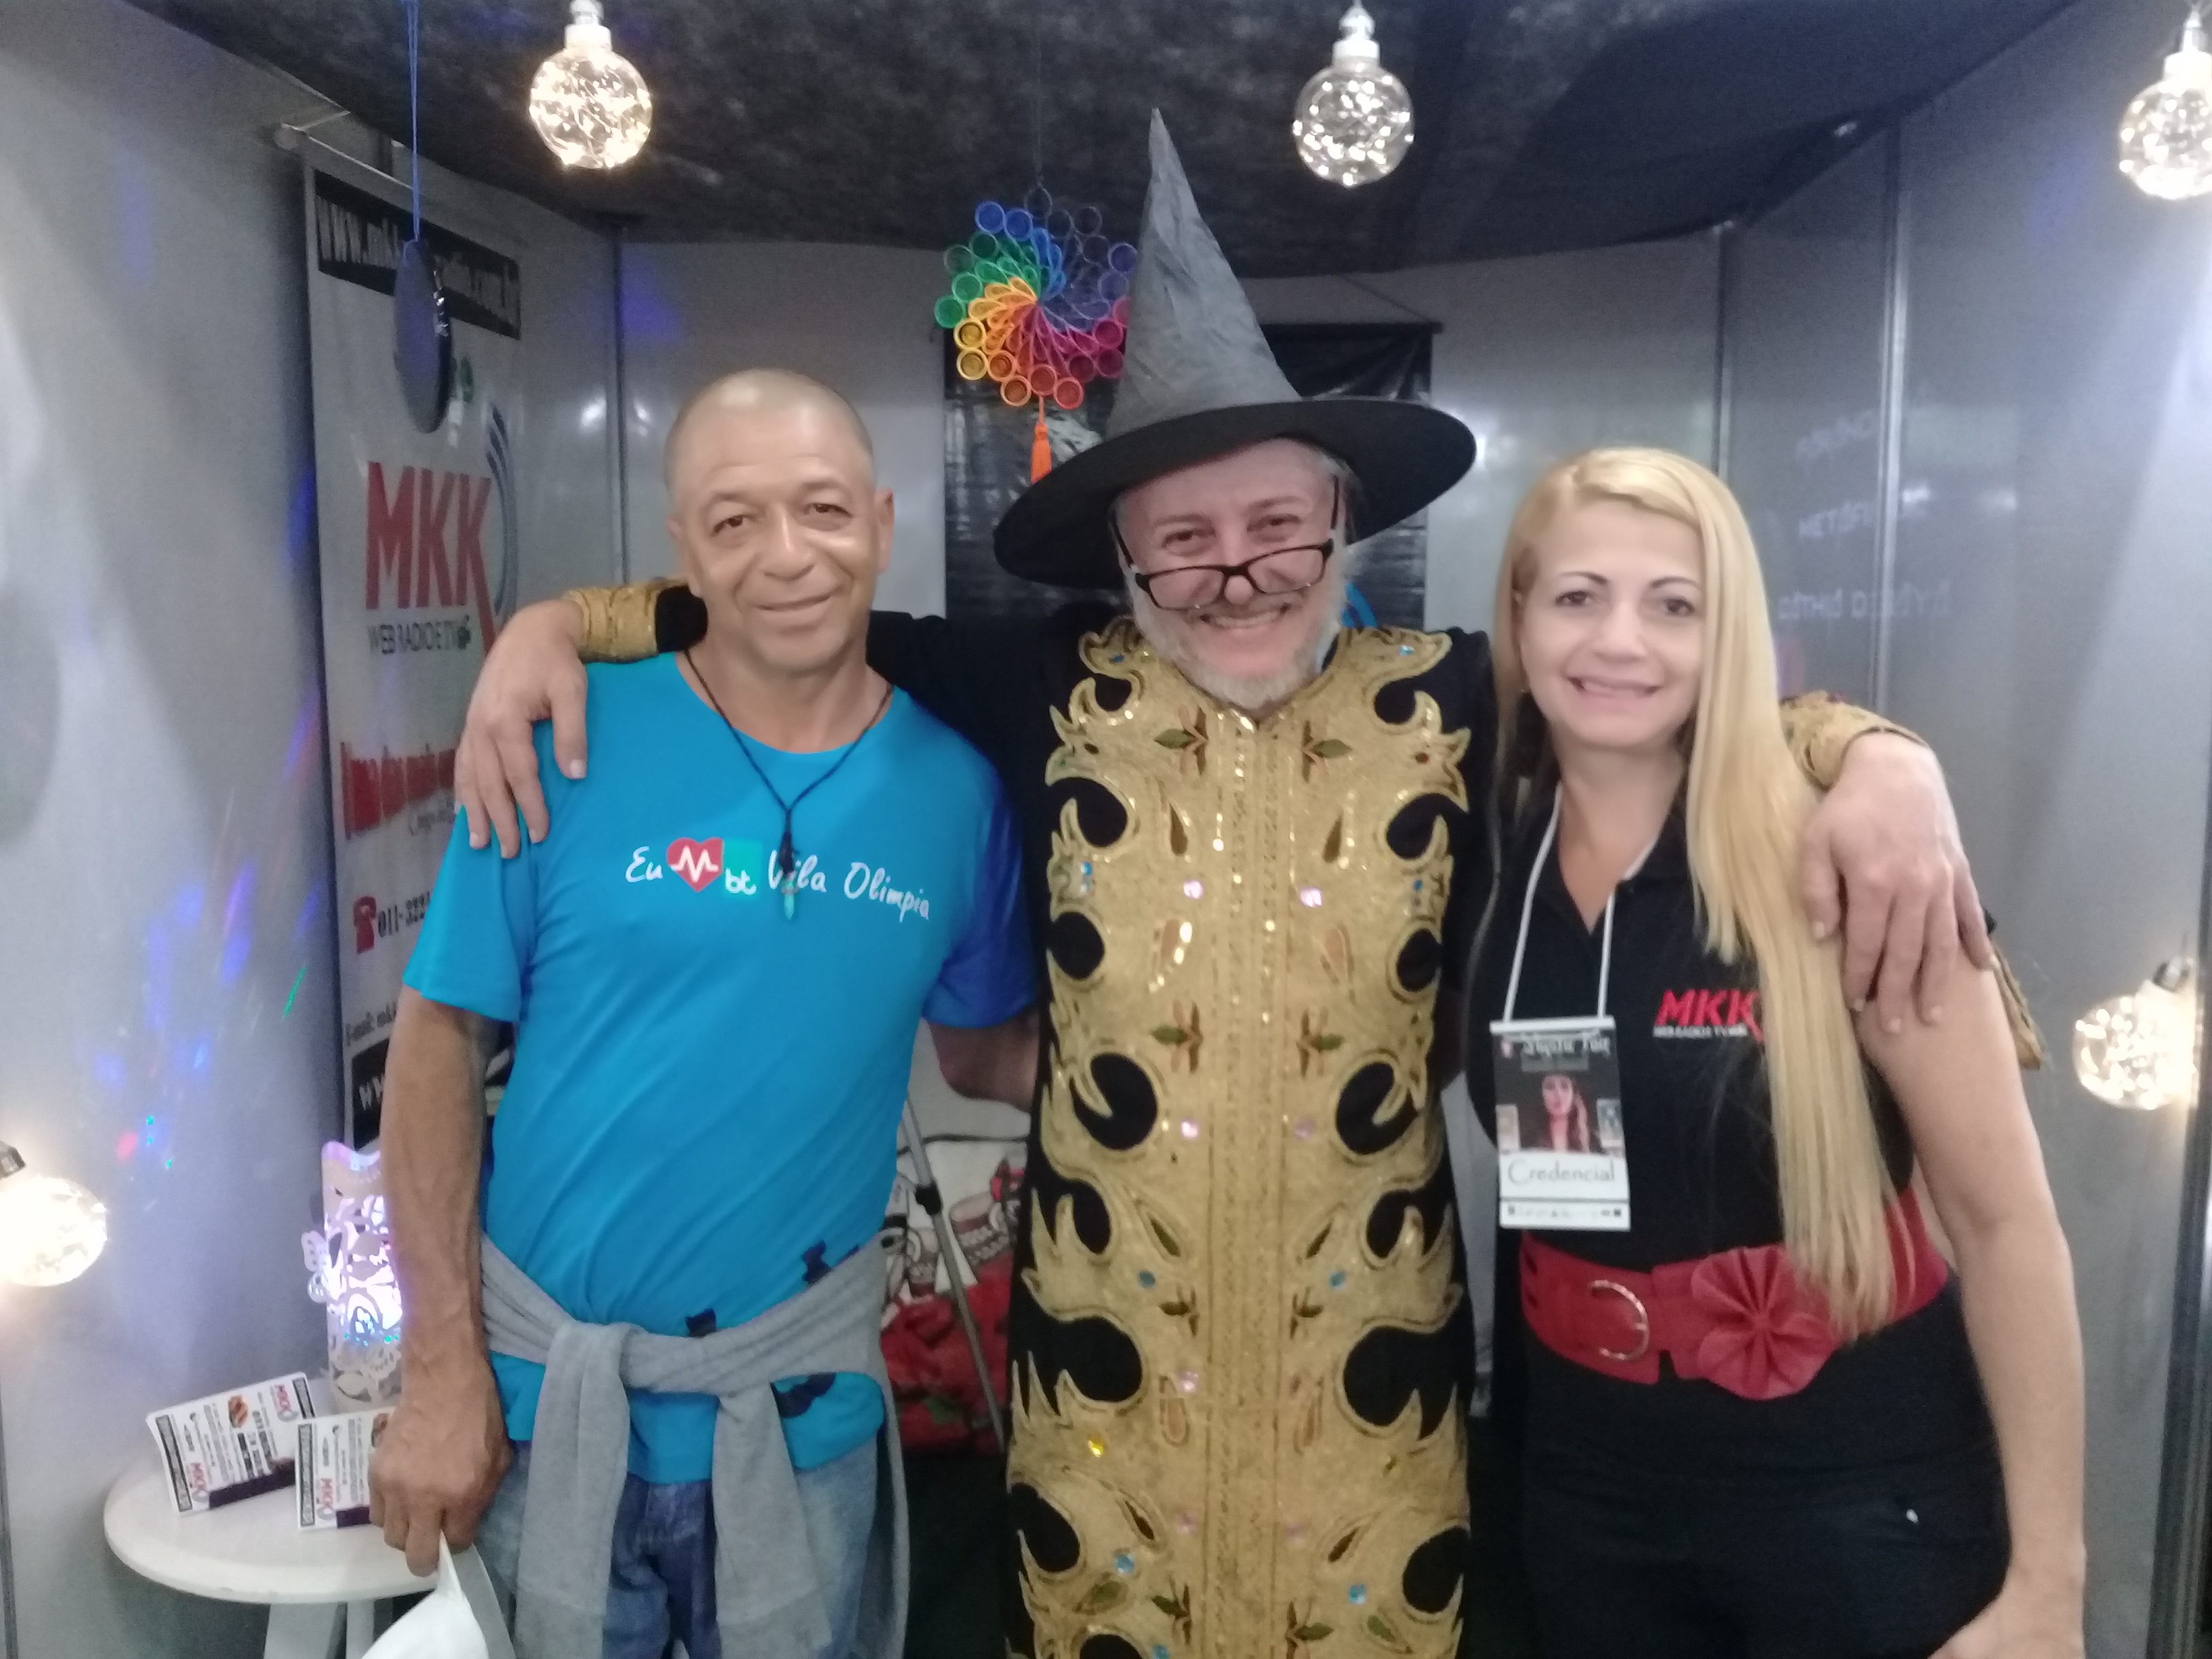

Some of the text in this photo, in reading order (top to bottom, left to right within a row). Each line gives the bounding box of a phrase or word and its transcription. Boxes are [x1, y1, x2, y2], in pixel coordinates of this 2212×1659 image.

[366, 460, 497, 655] MKK
[625, 845, 663, 882] Eu
[843, 861, 930, 923] Olimpia
[1655, 989, 1765, 1044] MKK
[1508, 1158, 1615, 1185] Credencial
